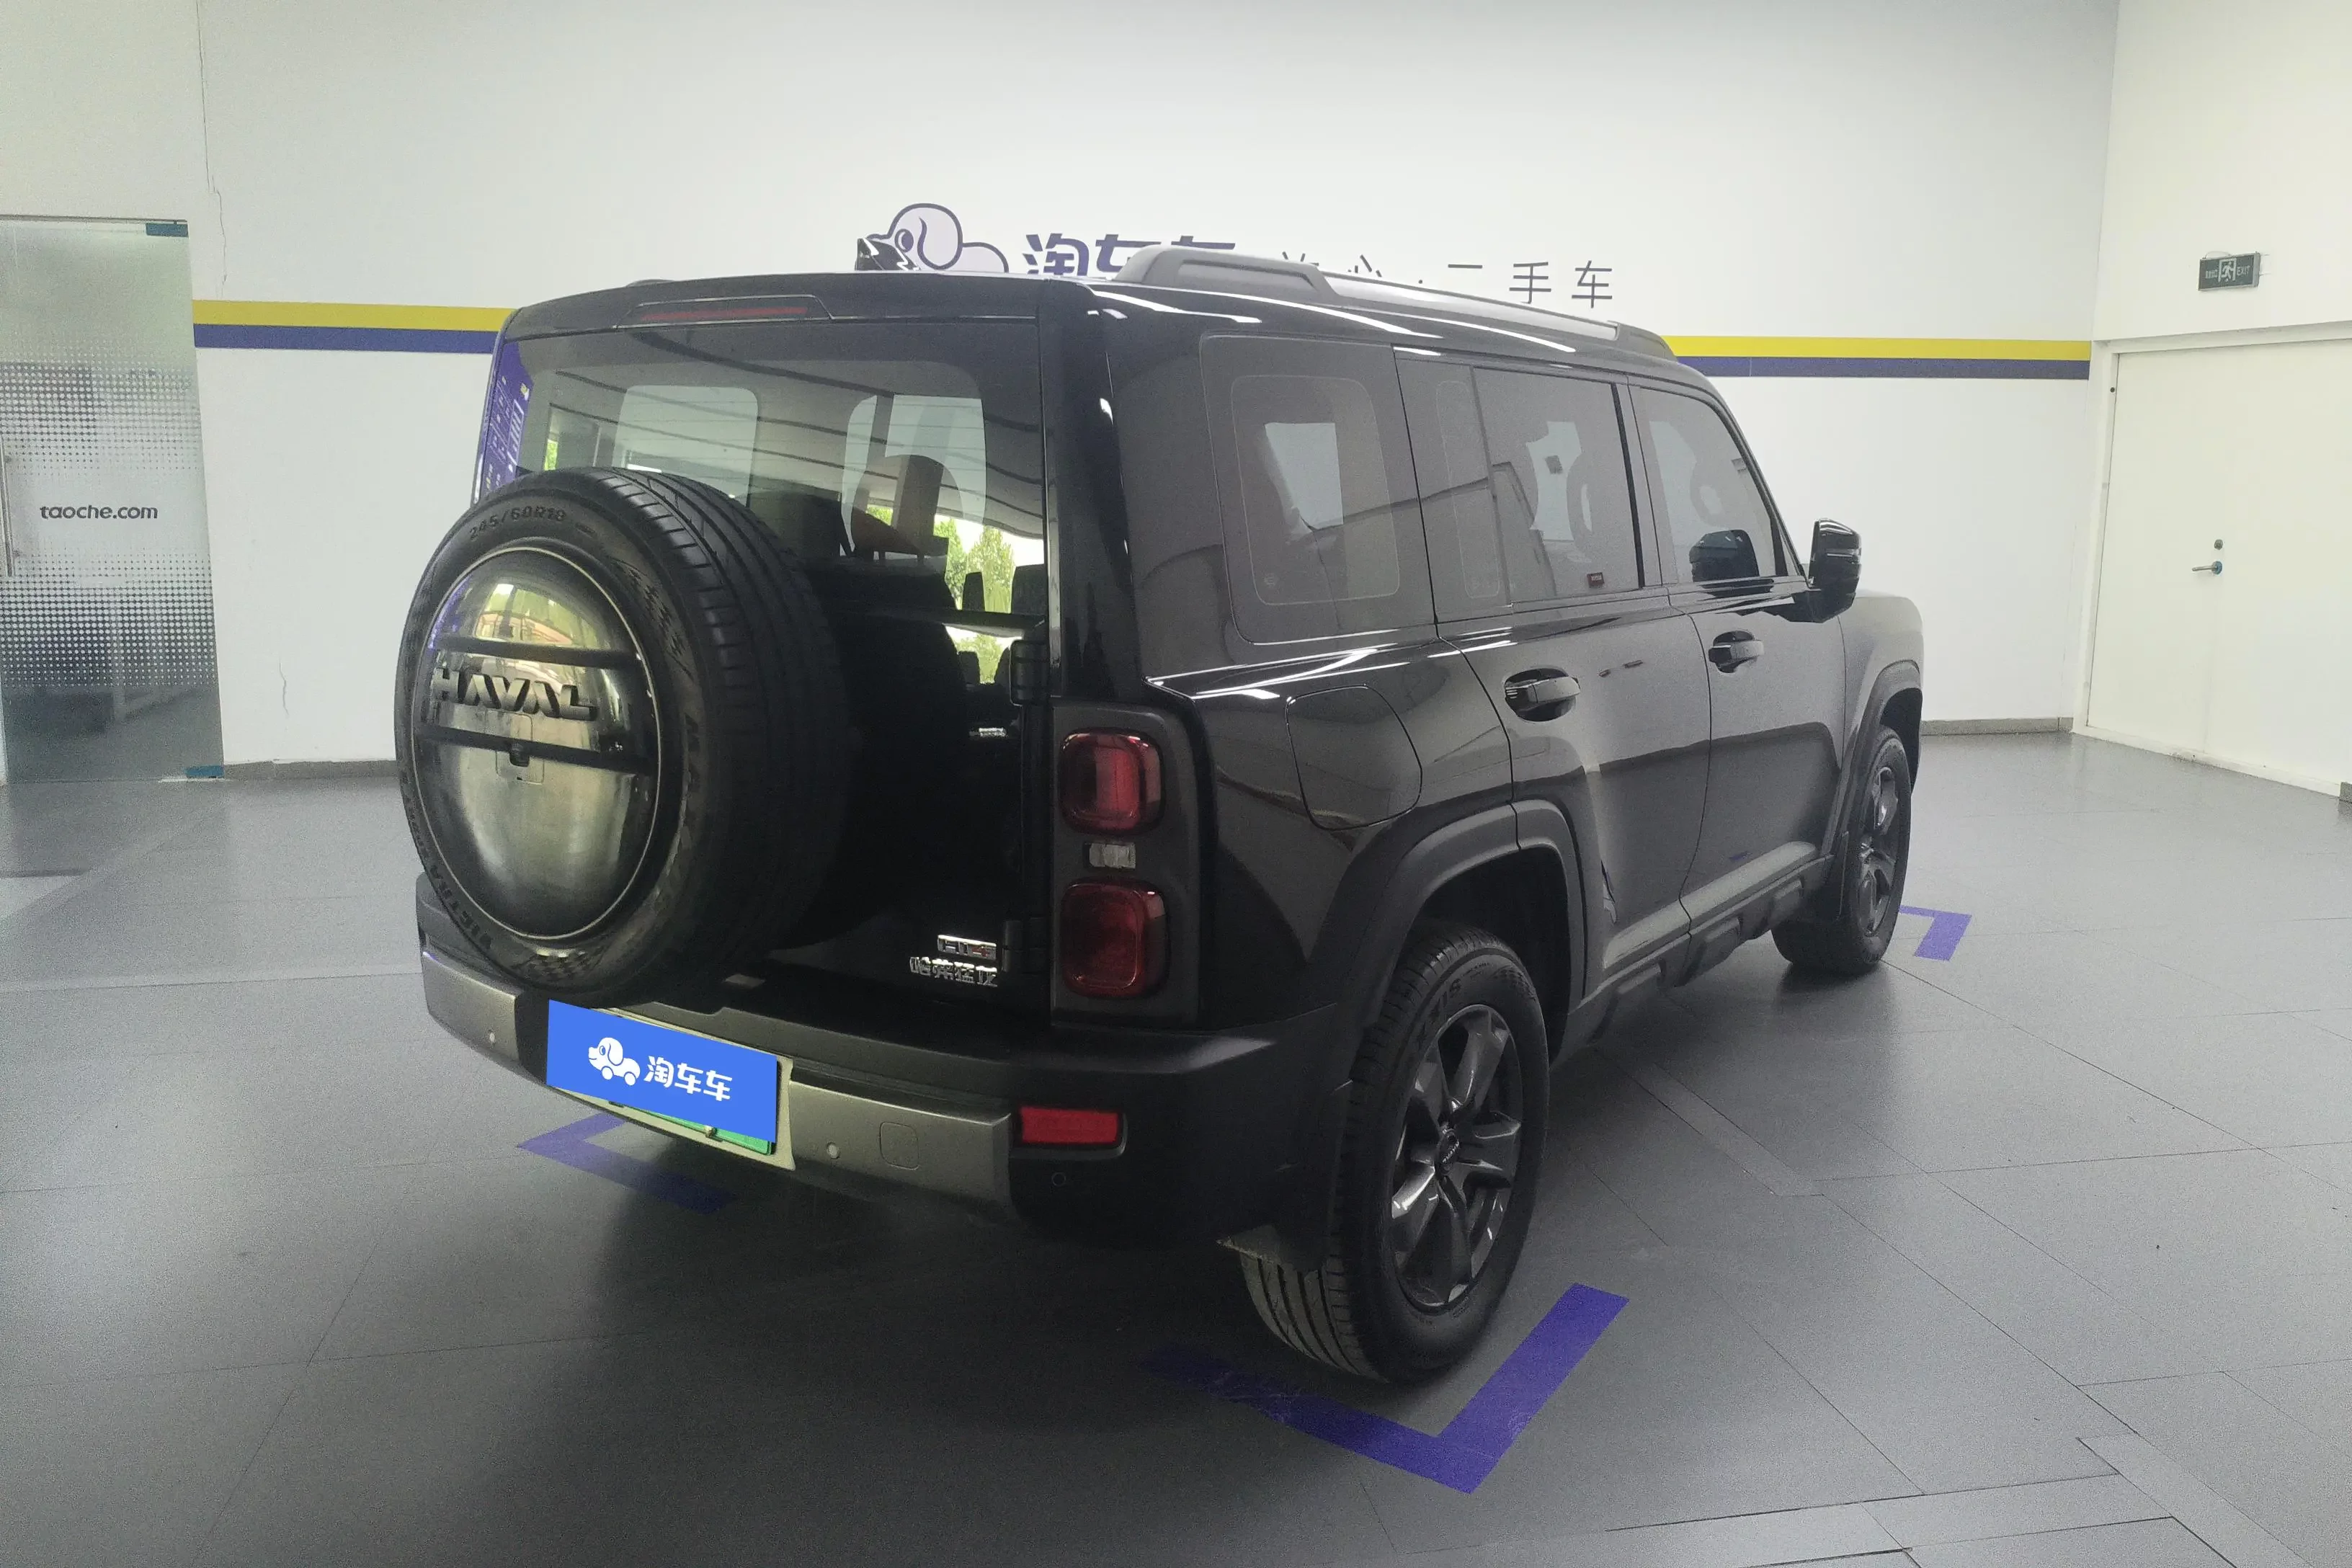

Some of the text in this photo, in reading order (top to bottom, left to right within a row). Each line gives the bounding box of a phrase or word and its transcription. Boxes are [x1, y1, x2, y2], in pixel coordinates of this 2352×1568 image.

[2237, 266, 2250, 276] EXIT
[40, 504, 159, 520] taoche.com
[429, 667, 597, 721] HAVAL
